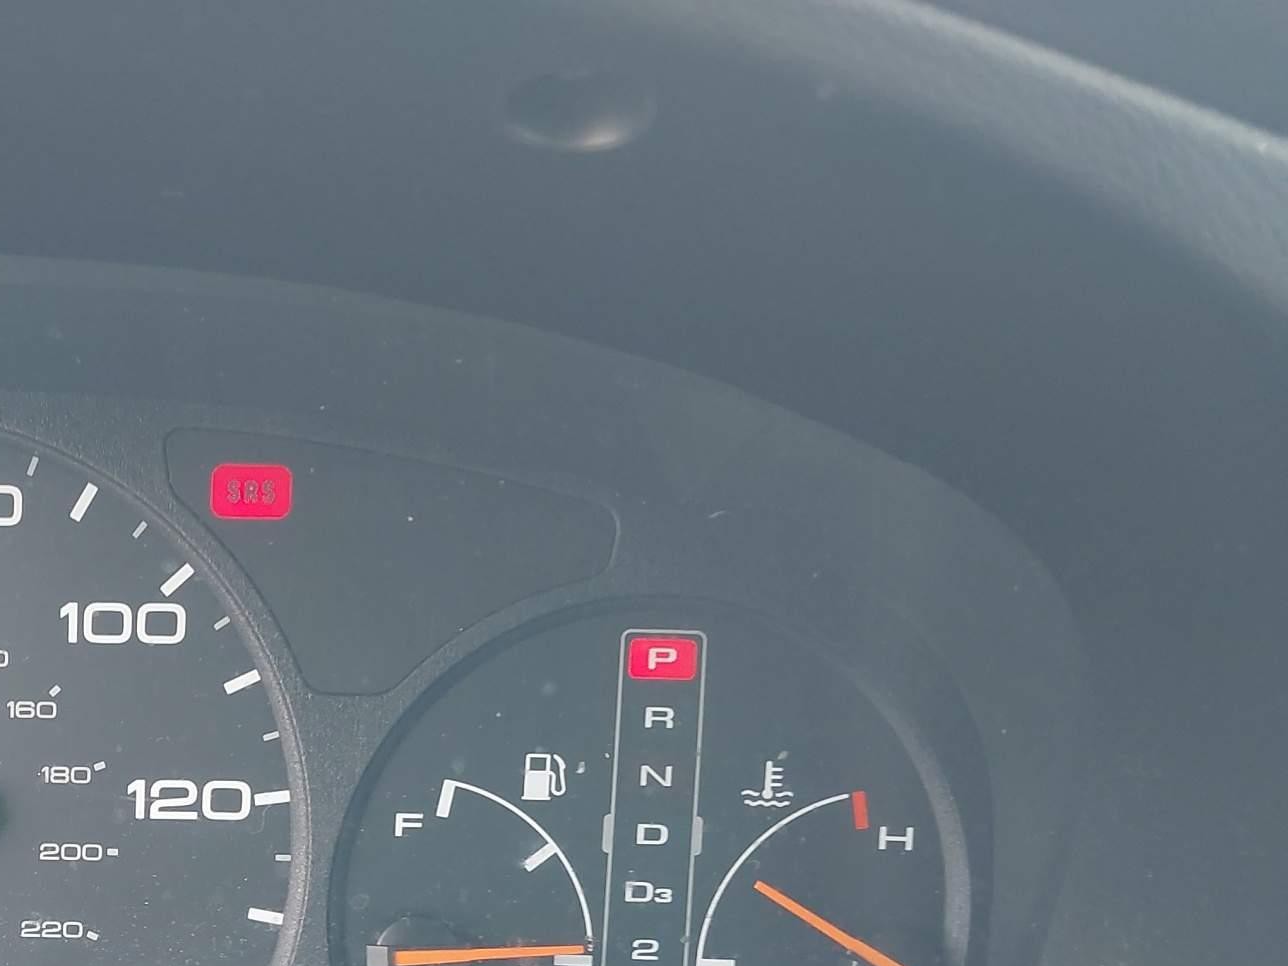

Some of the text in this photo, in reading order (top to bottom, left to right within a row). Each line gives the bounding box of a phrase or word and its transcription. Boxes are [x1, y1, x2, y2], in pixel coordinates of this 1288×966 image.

[226, 480, 277, 504] SRS
[59, 602, 187, 645] 100
[647, 648, 678, 670] P
[6, 701, 57, 719] 160
[644, 706, 674, 729] R
[41, 767, 91, 784] 180
[640, 765, 673, 788] N
[127, 779, 252, 821] 120
[394, 813, 424, 837] F
[636, 825, 668, 846] D
[878, 826, 914, 851] H
[39, 843, 103, 862] 200
[625, 881, 673, 904] D3
[20, 920, 84, 939] 220
[632, 939, 659, 961] 2
